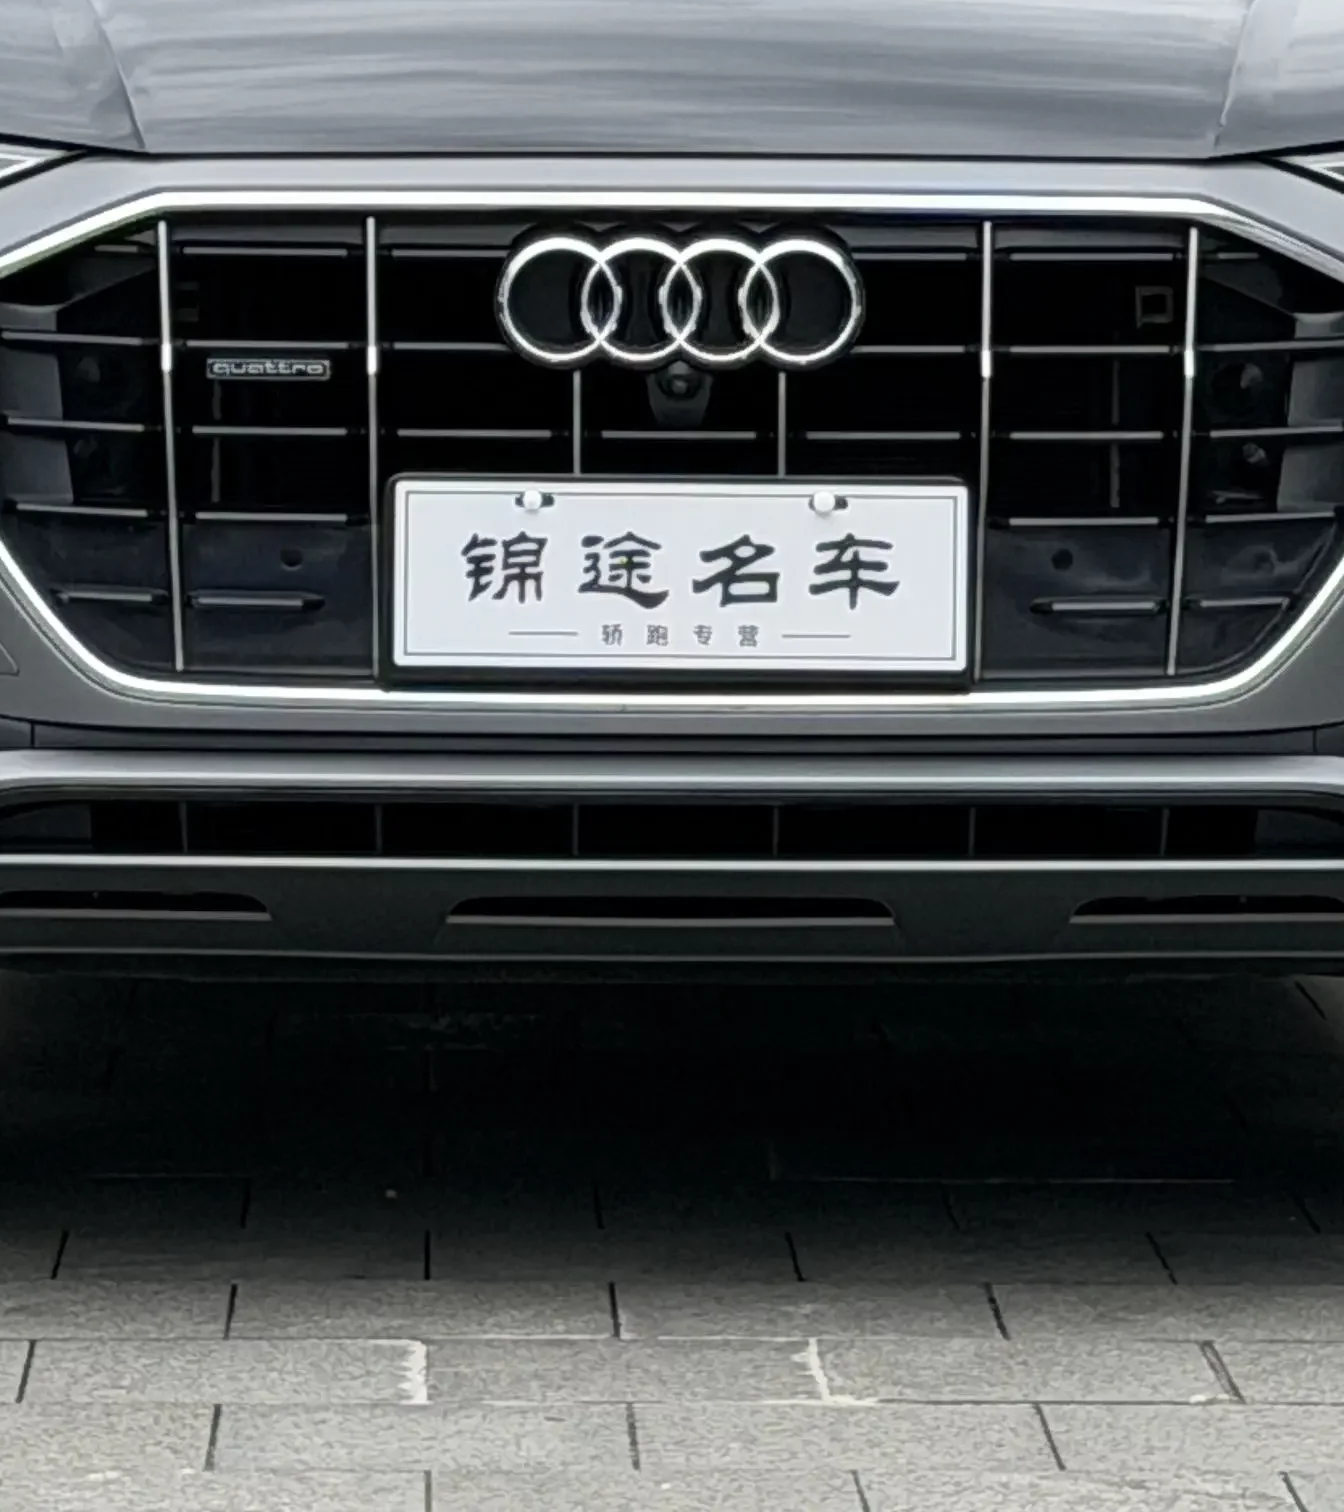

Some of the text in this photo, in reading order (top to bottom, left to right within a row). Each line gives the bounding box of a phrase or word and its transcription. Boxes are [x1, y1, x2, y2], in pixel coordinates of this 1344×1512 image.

[212, 360, 325, 376] quattro
[460, 530, 902, 611] 锦途名车
[600, 623, 760, 649] 轿跑专营
